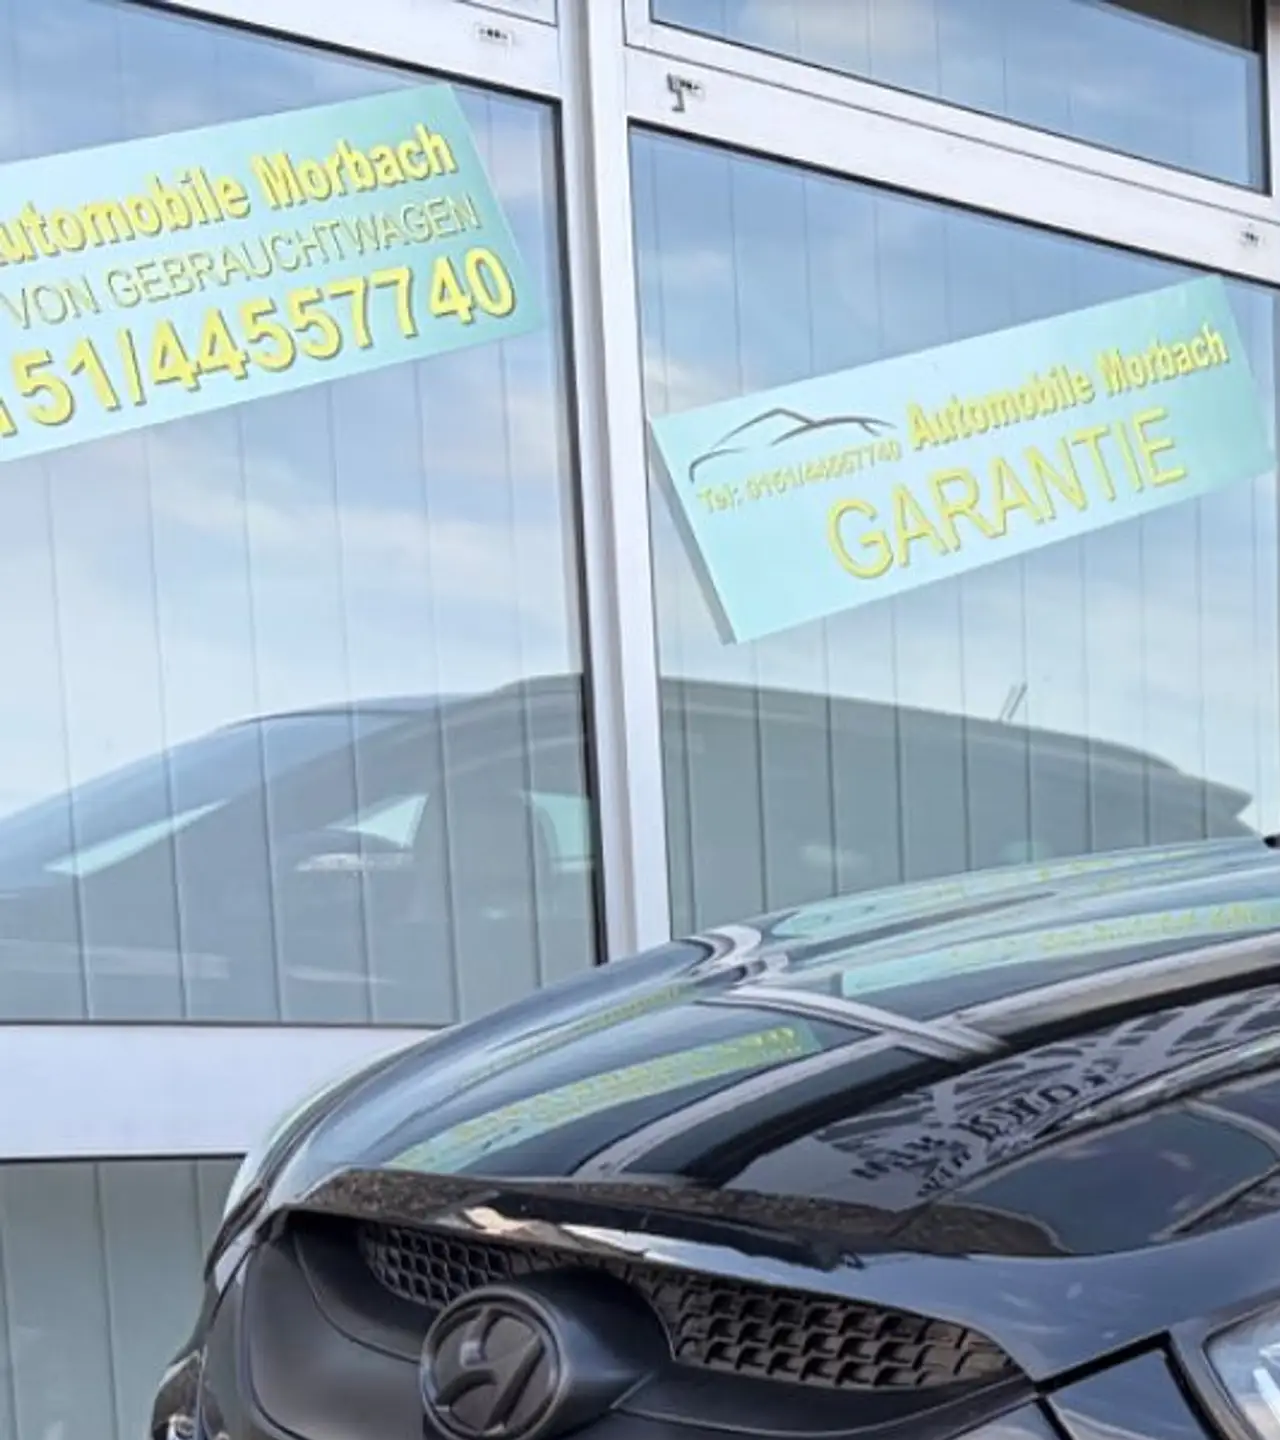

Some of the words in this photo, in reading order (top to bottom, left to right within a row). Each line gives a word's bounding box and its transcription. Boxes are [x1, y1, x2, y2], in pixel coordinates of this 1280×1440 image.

[254, 123, 458, 212] Morbach
[3, 274, 102, 331] VON
[106, 192, 484, 310] GEBRAUCHTWAGEN
[907, 364, 1097, 452] Automobile
[1097, 323, 1230, 397] Morbach
[826, 405, 1190, 582] GARANTIE
